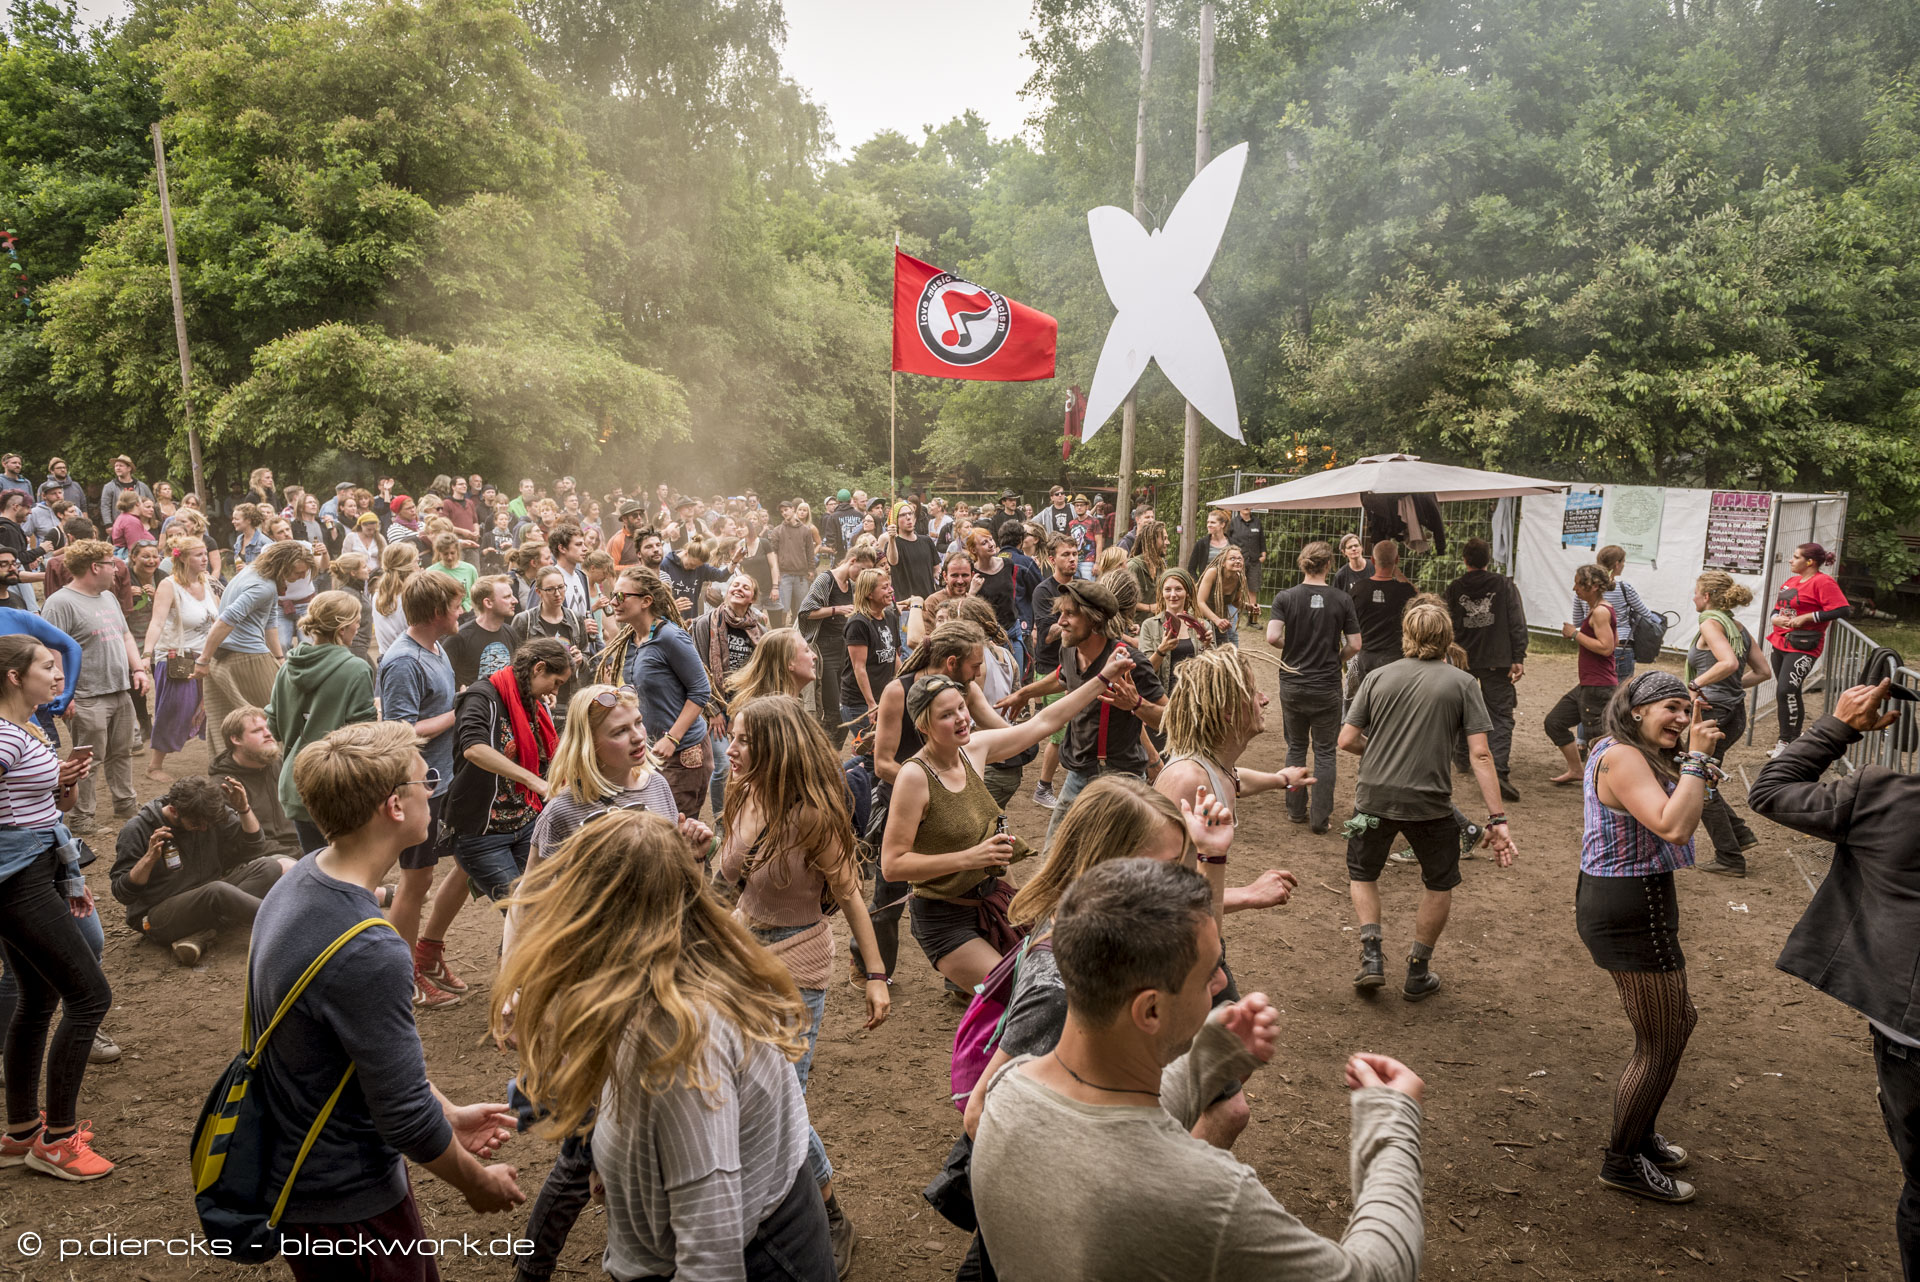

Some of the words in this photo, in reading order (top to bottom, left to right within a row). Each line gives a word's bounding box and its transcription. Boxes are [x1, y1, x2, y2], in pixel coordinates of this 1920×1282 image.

[920, 301, 929, 326] love
[927, 275, 952, 298] music
[1712, 493, 1771, 508] ACKER
[1787, 694, 1798, 714] KILL
